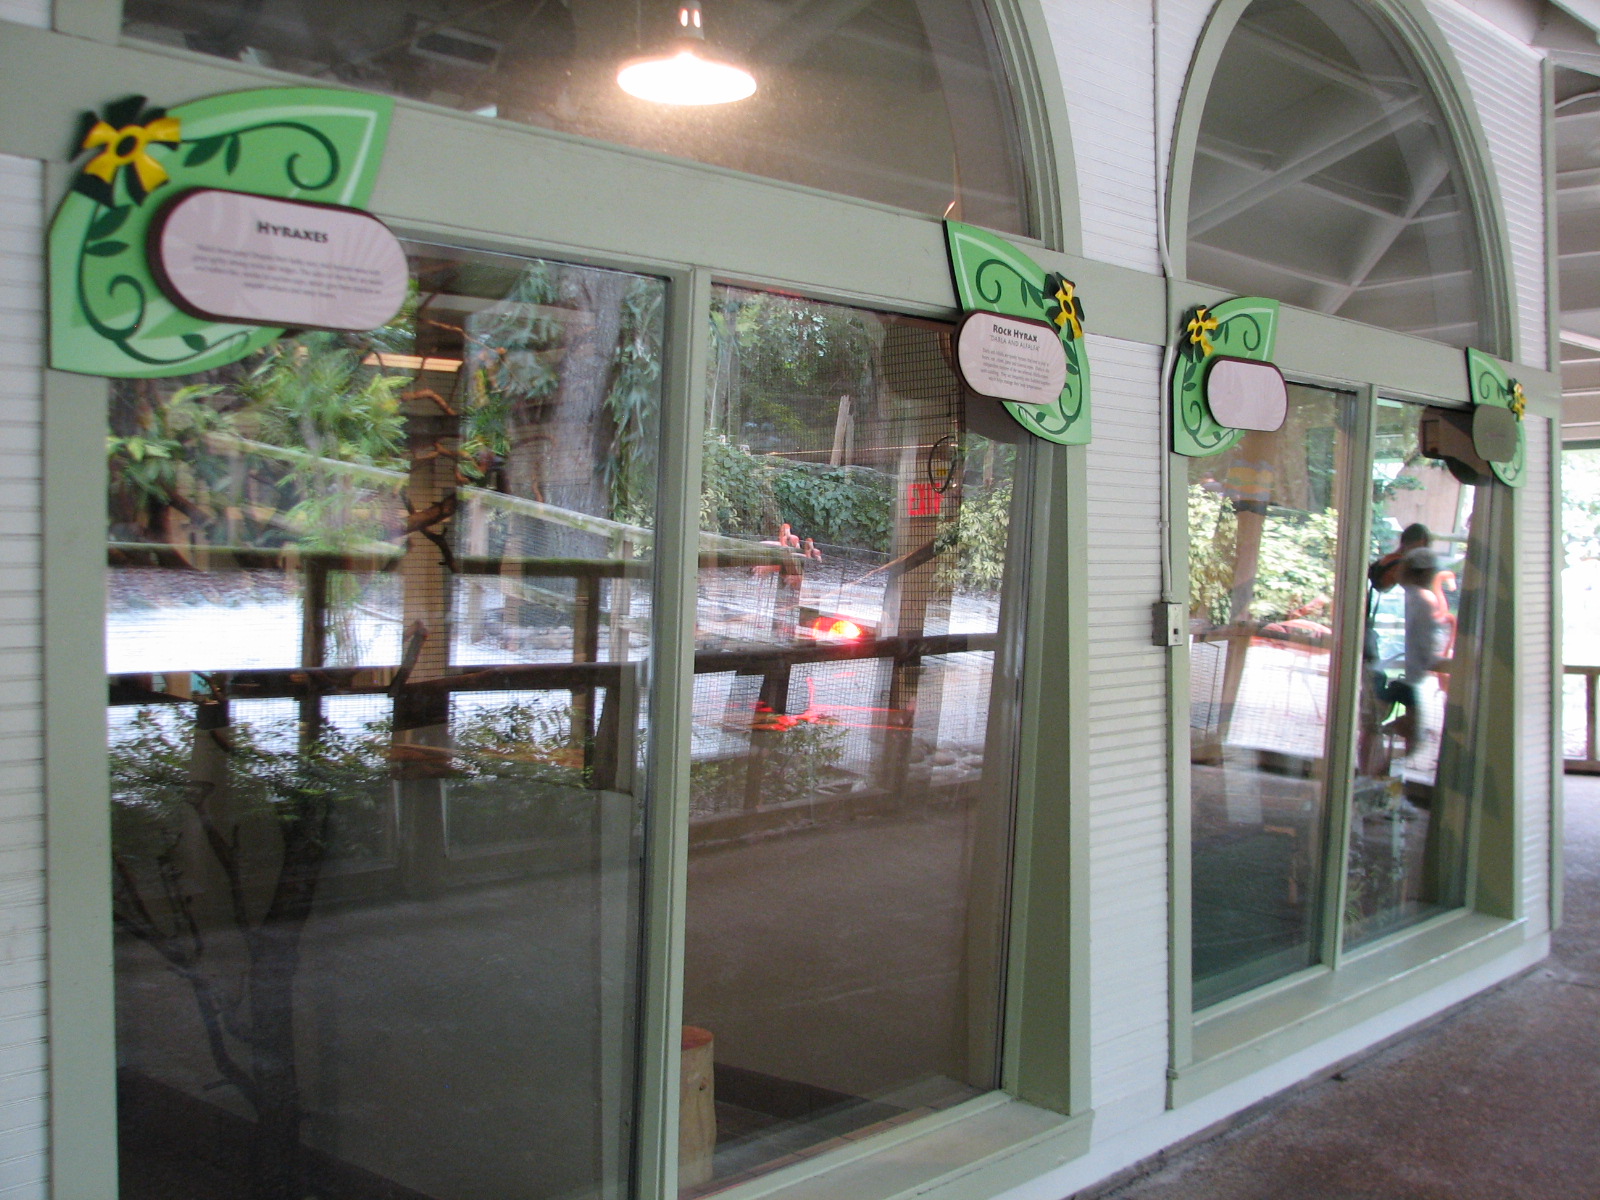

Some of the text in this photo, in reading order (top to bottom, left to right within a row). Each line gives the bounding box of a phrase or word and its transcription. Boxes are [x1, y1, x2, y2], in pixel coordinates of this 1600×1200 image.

[256, 220, 328, 243] HYRAXES
[993, 324, 1038, 342] ROCK HYRAX
